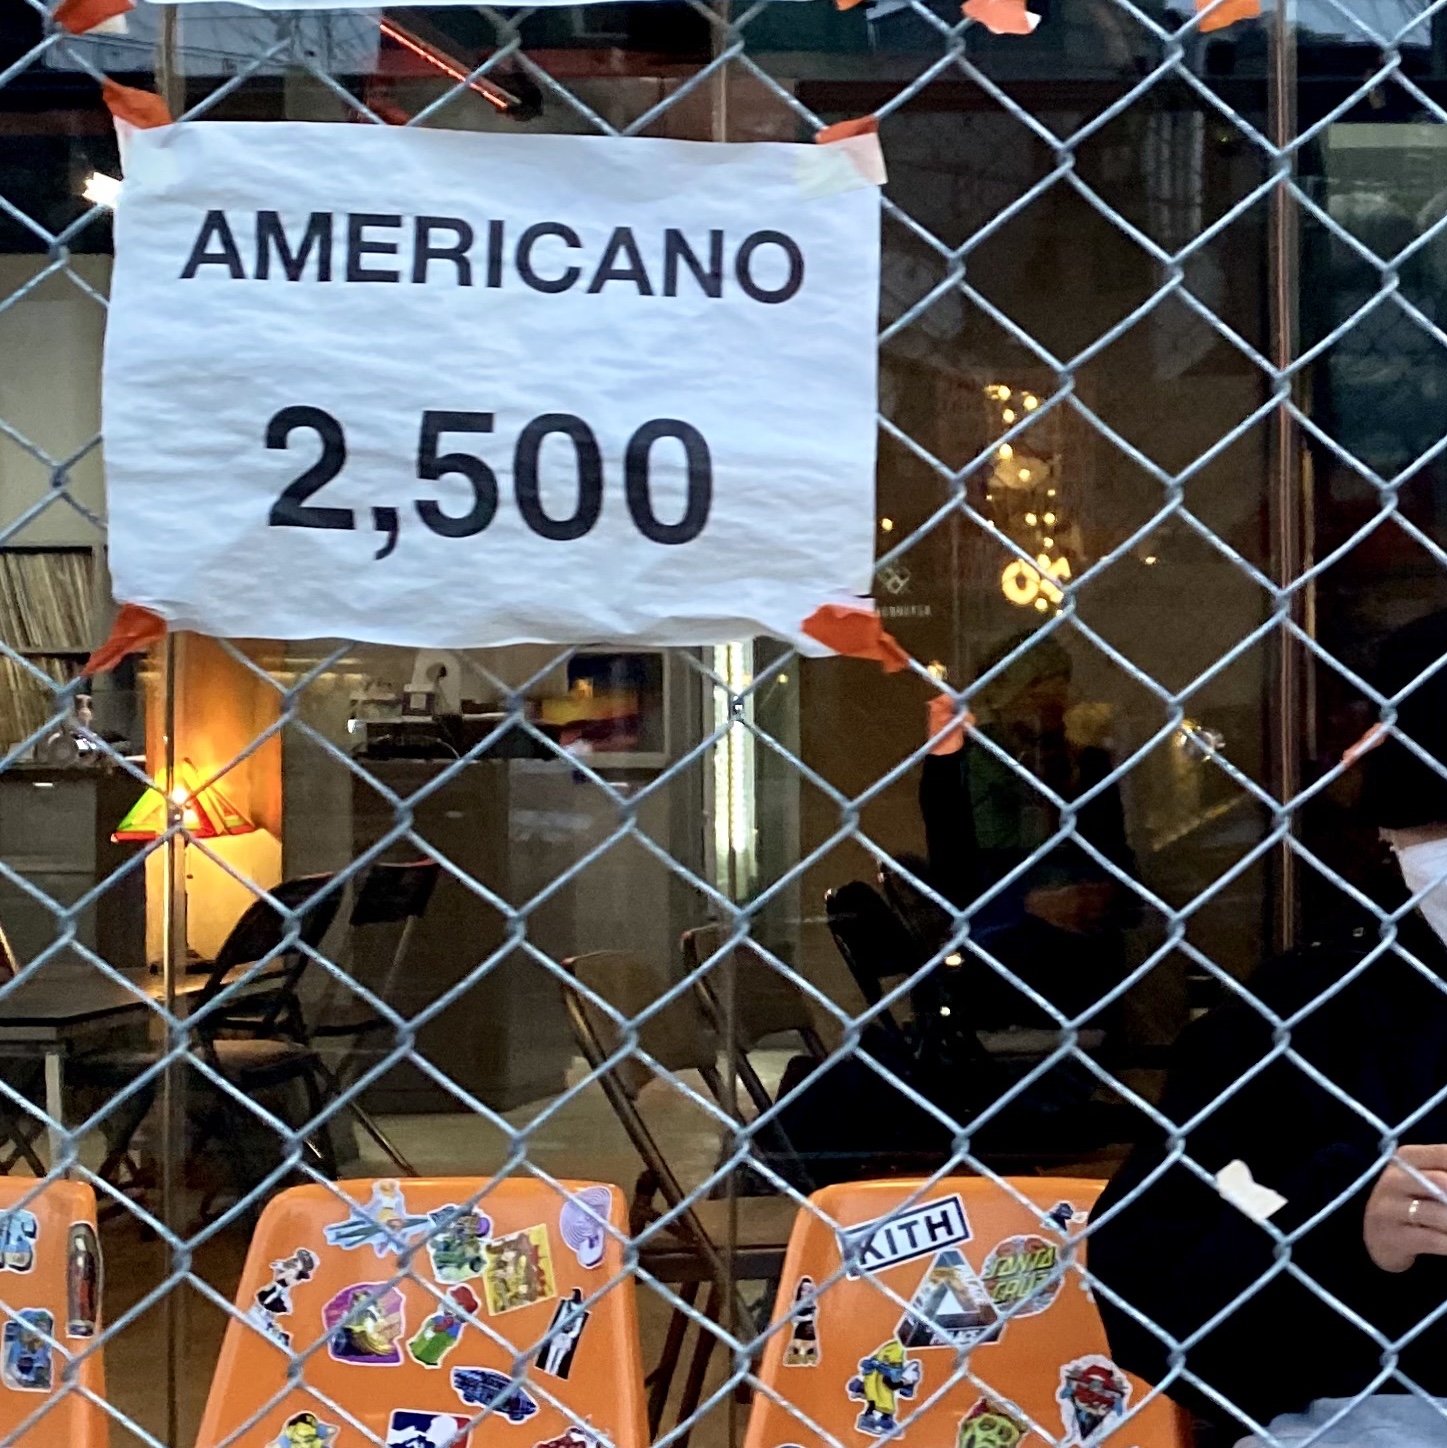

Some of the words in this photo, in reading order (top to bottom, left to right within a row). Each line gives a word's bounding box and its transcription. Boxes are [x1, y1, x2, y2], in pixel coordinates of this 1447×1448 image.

[181, 210, 803, 304] AMERICANO
[264, 406, 713, 560] 2,500
[859, 1209, 954, 1265] KITH
[981, 1244, 1056, 1281] SANTA
